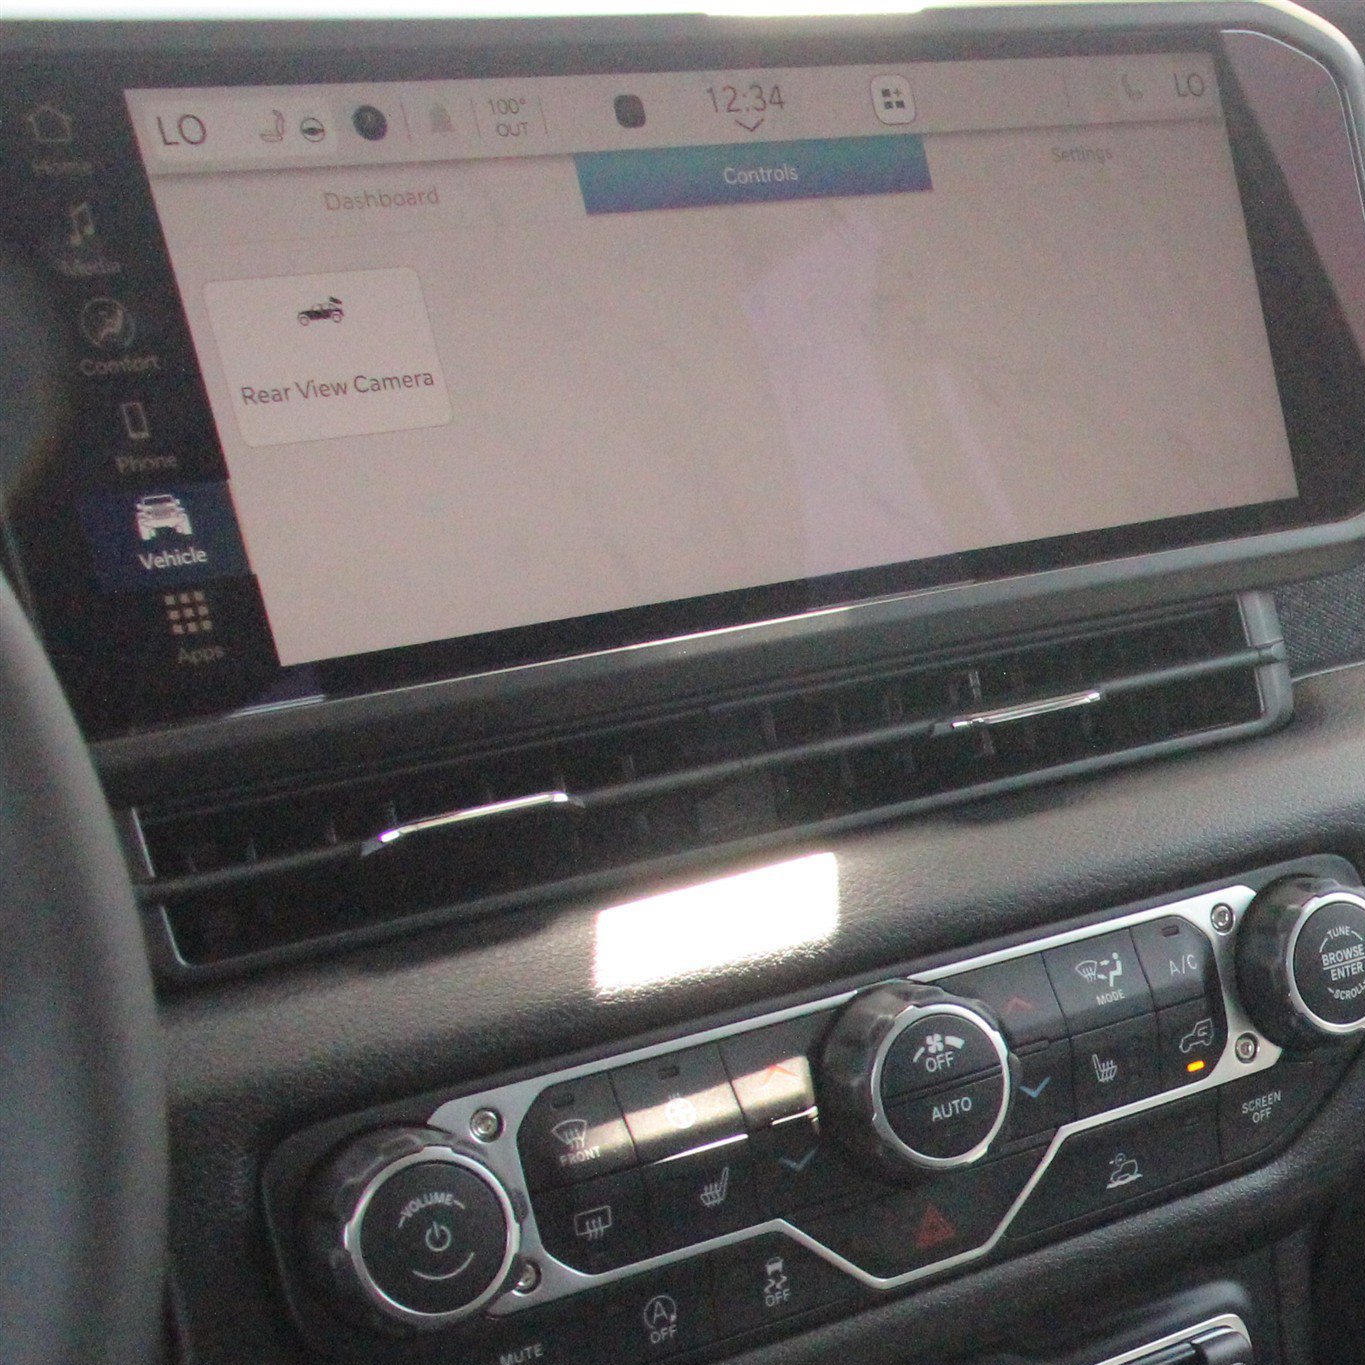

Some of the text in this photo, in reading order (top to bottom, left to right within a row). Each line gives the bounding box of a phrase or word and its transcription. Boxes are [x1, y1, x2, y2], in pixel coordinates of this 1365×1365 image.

[1173, 72, 1206, 97] LO
[706, 84, 785, 113] 12:34
[156, 113, 208, 147] LO
[496, 122, 528, 137] OUT
[722, 163, 799, 185] Controls
[323, 186, 440, 213] Dashboard
[241, 372, 434, 406] Rear View Camera
[138, 547, 207, 570] Vehicle
[1327, 926, 1350, 939] TUNE
[1169, 954, 1197, 976] A/C
[1321, 944, 1365, 966] BROWSE
[1330, 962, 1364, 981] ENTER
[1096, 989, 1125, 1006] MODE
[1333, 982, 1365, 1000] SCROLL
[925, 1051, 953, 1072] OFF
[932, 1097, 972, 1123] AUTO
[1241, 1090, 1281, 1114] SCREEN
[1252, 1107, 1271, 1123] OFF
[560, 1145, 600, 1166] FRONT
[400, 1191, 453, 1217] VOLUME
[764, 1288, 790, 1307] OFF
[650, 1324, 677, 1345] OFF
